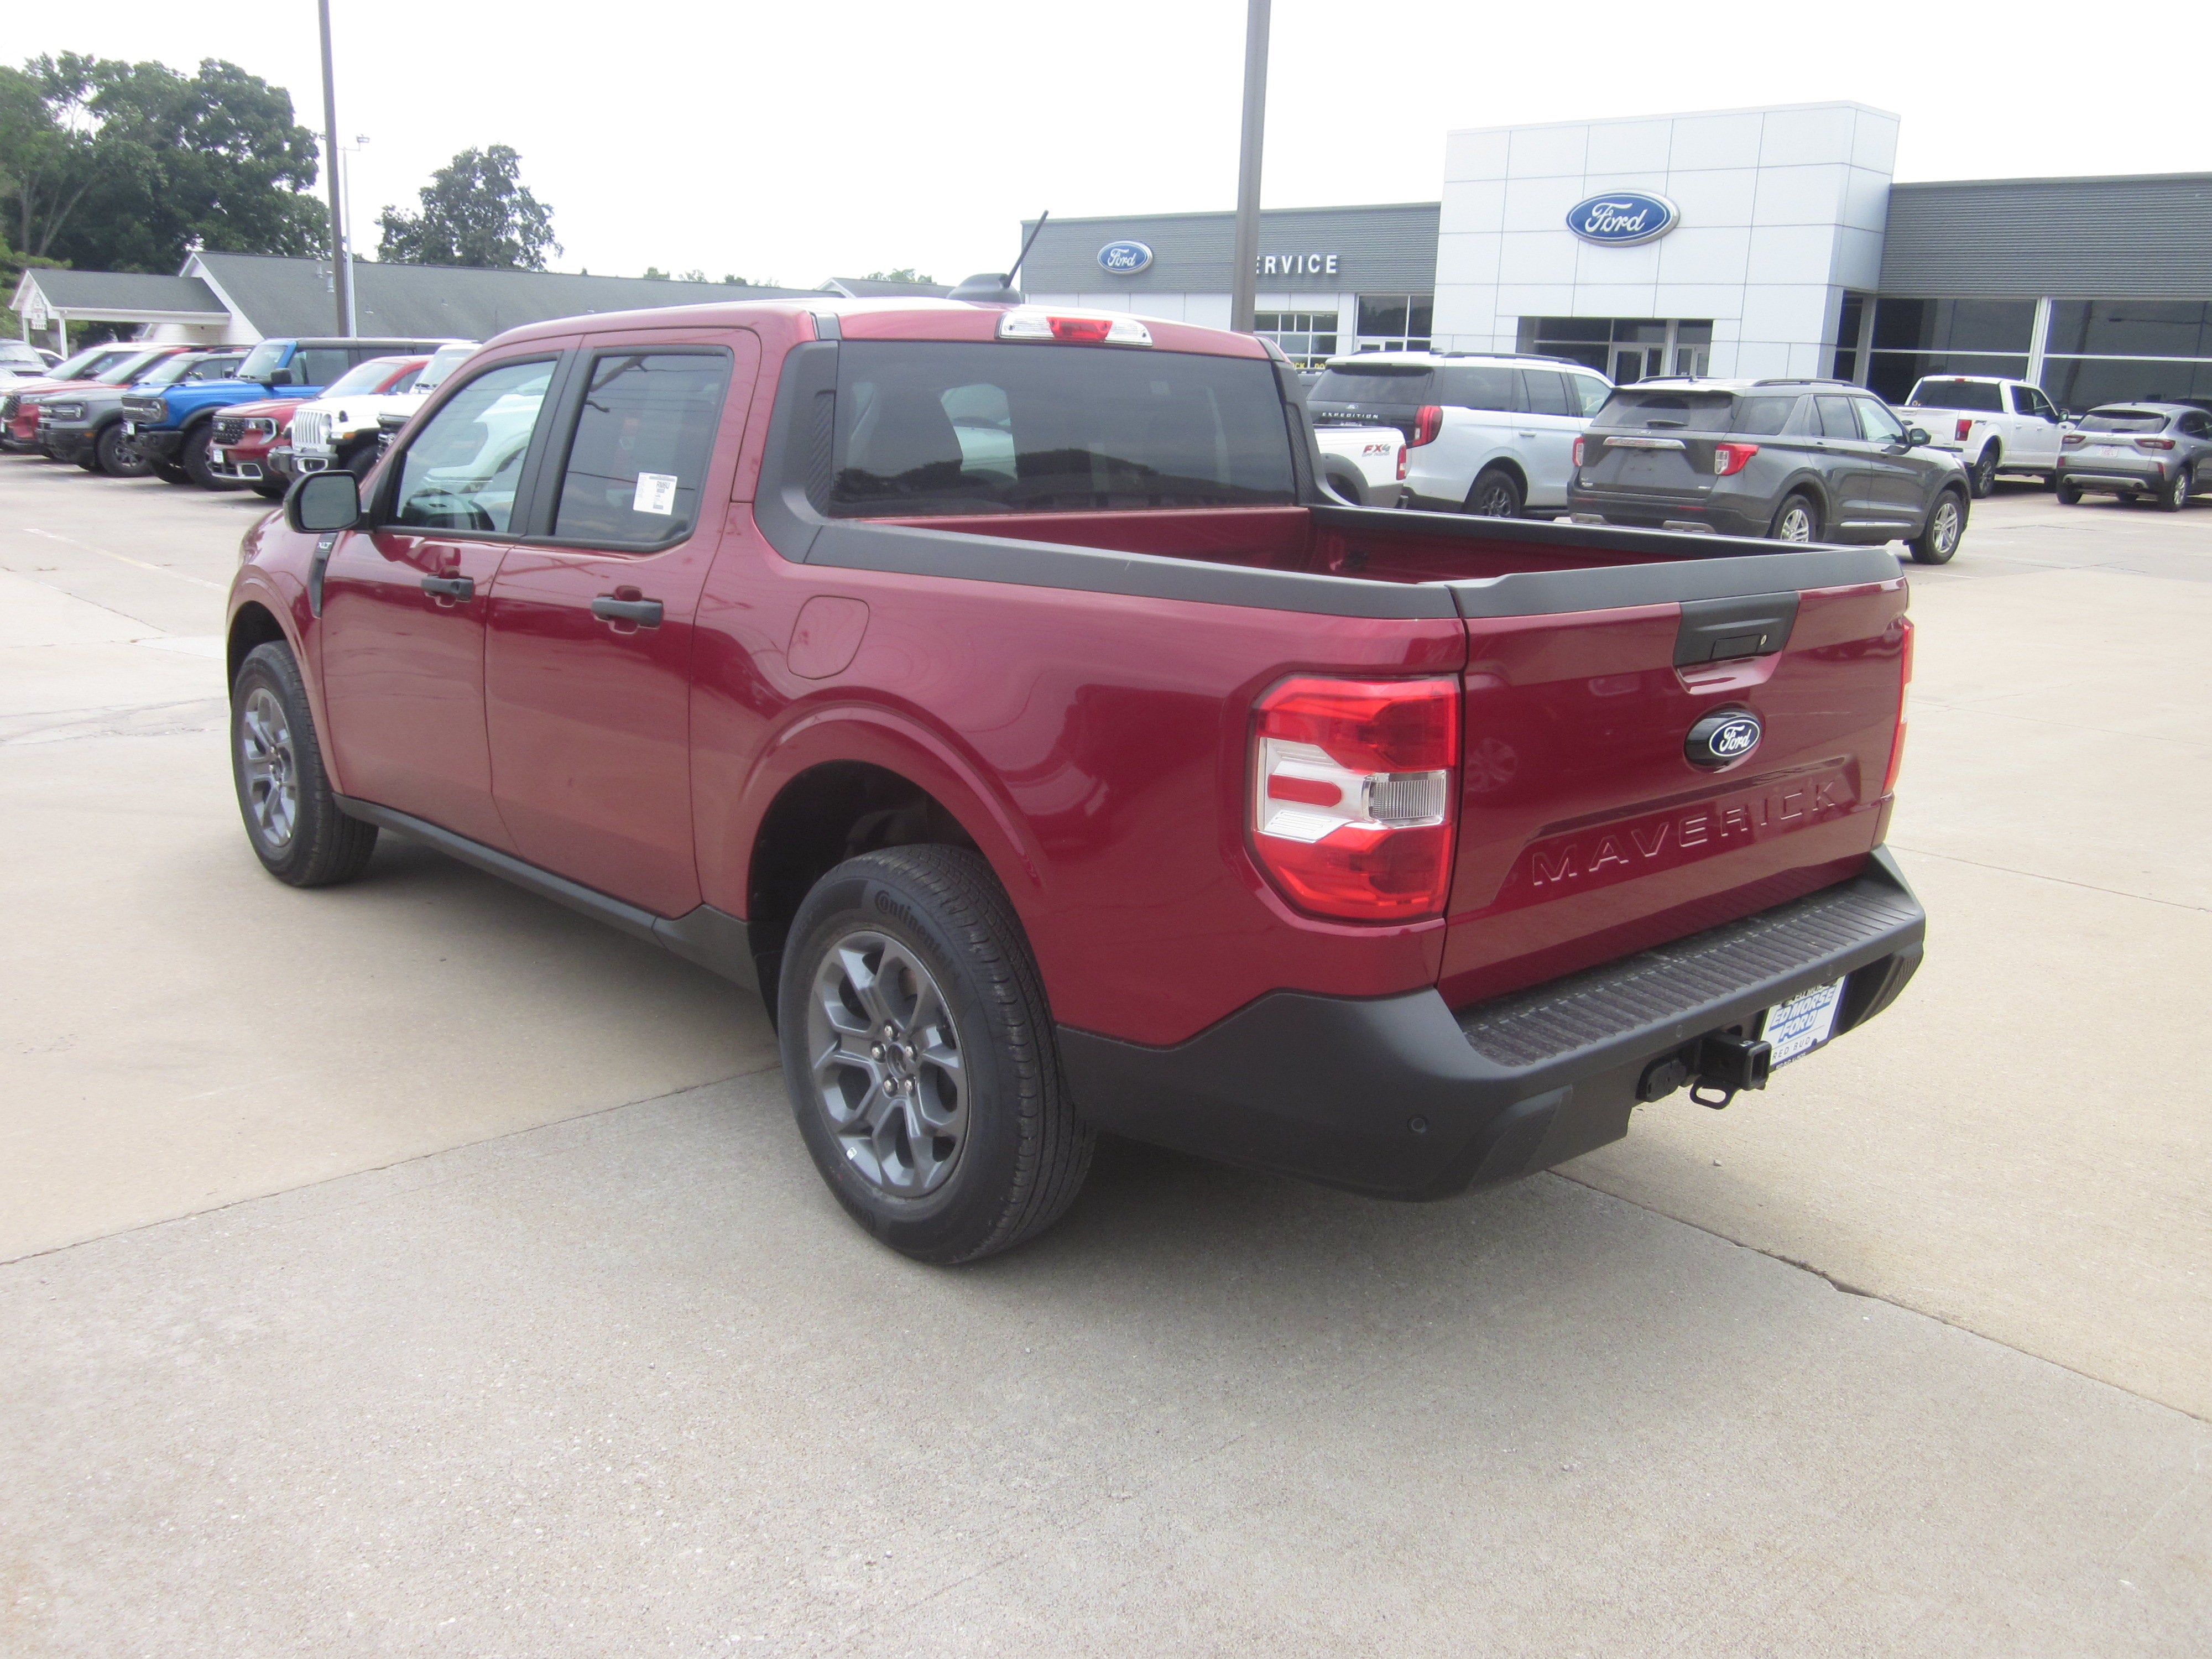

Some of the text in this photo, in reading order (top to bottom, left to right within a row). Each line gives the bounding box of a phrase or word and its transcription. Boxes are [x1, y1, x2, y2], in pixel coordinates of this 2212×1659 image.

[1585, 202, 1648, 233] Ford
[1107, 248, 1137, 267] Ford
[1255, 254, 1338, 274] RVICE
[1363, 444, 1391, 453] FX4
[1719, 724, 1752, 752] Ford
[1532, 780, 1836, 886] MAVERICK
[1769, 1004, 1793, 1032] ED
[1787, 984, 1837, 1022] MORSE
[1778, 1008, 1819, 1044] FORD
[1772, 1036, 1811, 1061] RED BUD
